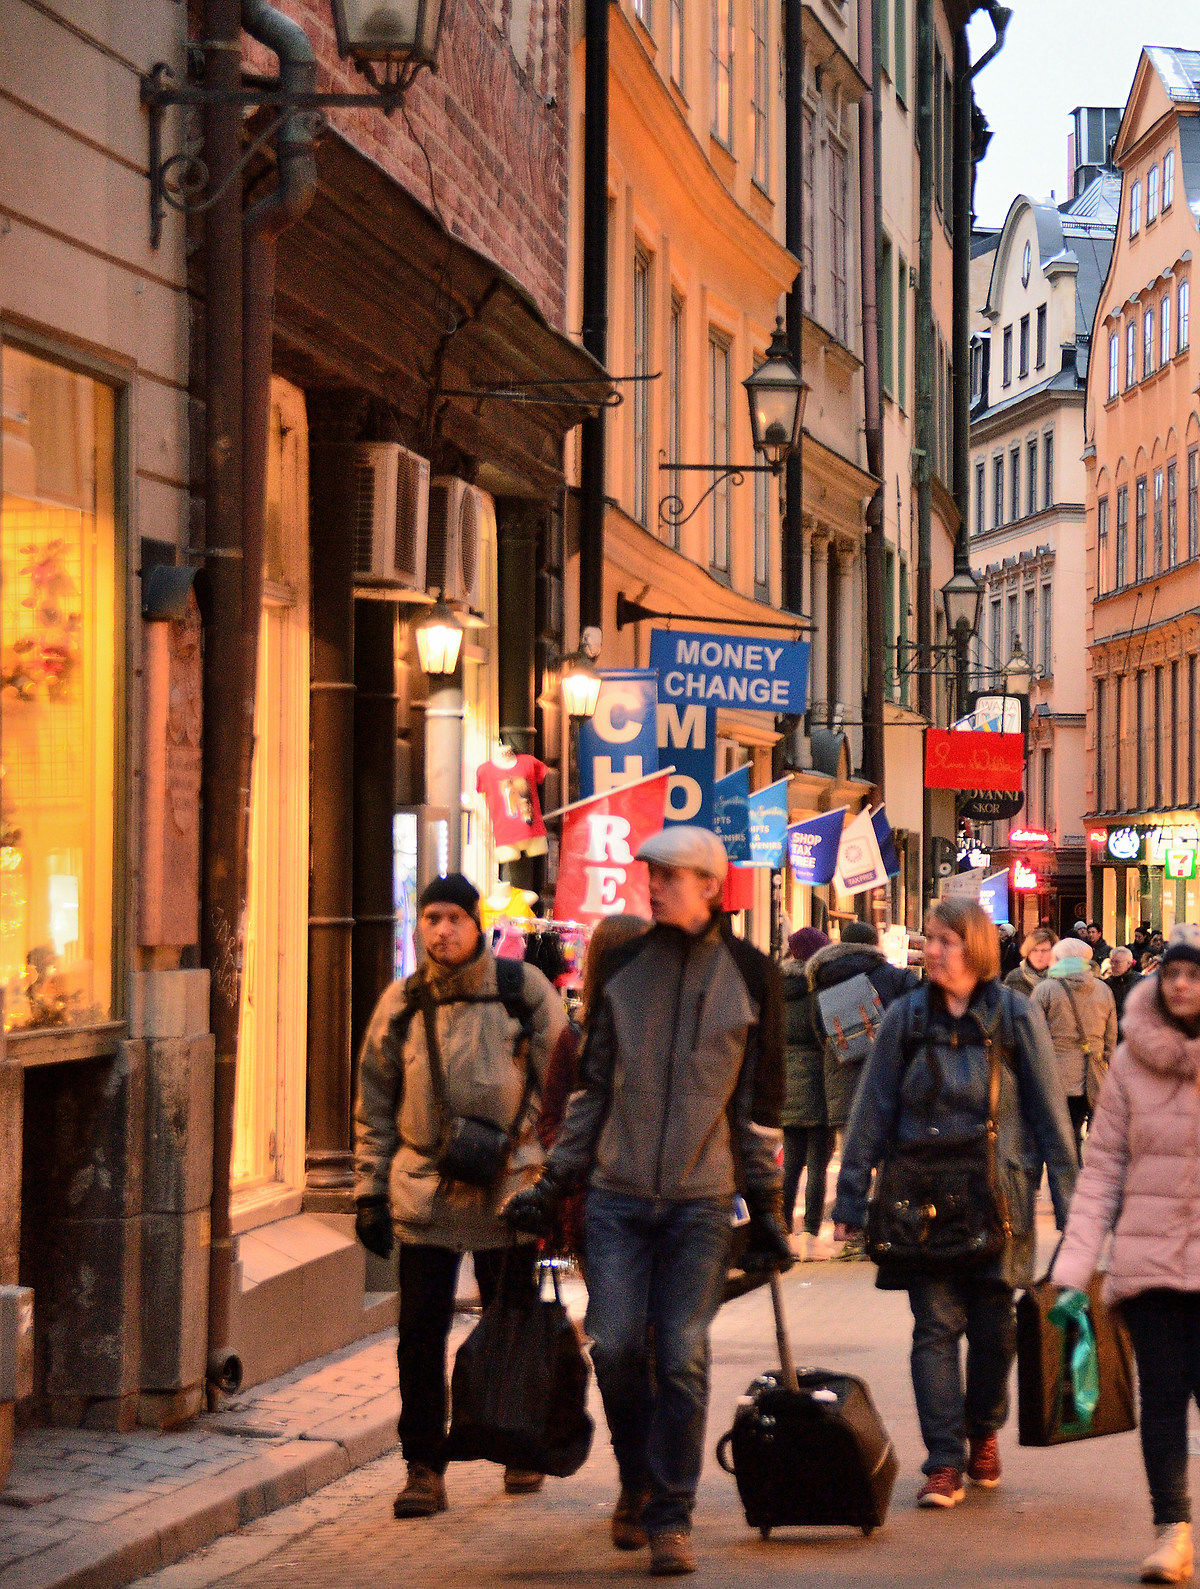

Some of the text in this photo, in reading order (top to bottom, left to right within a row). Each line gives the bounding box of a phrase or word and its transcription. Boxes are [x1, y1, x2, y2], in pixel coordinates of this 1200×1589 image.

[676, 639, 785, 671] MONEY
[665, 671, 791, 705] CHANGE
[972, 803, 1001, 814] SKOR
[791, 831, 823, 847] SHOP
[791, 843, 813, 856] TAX
[790, 854, 817, 869] FREE
